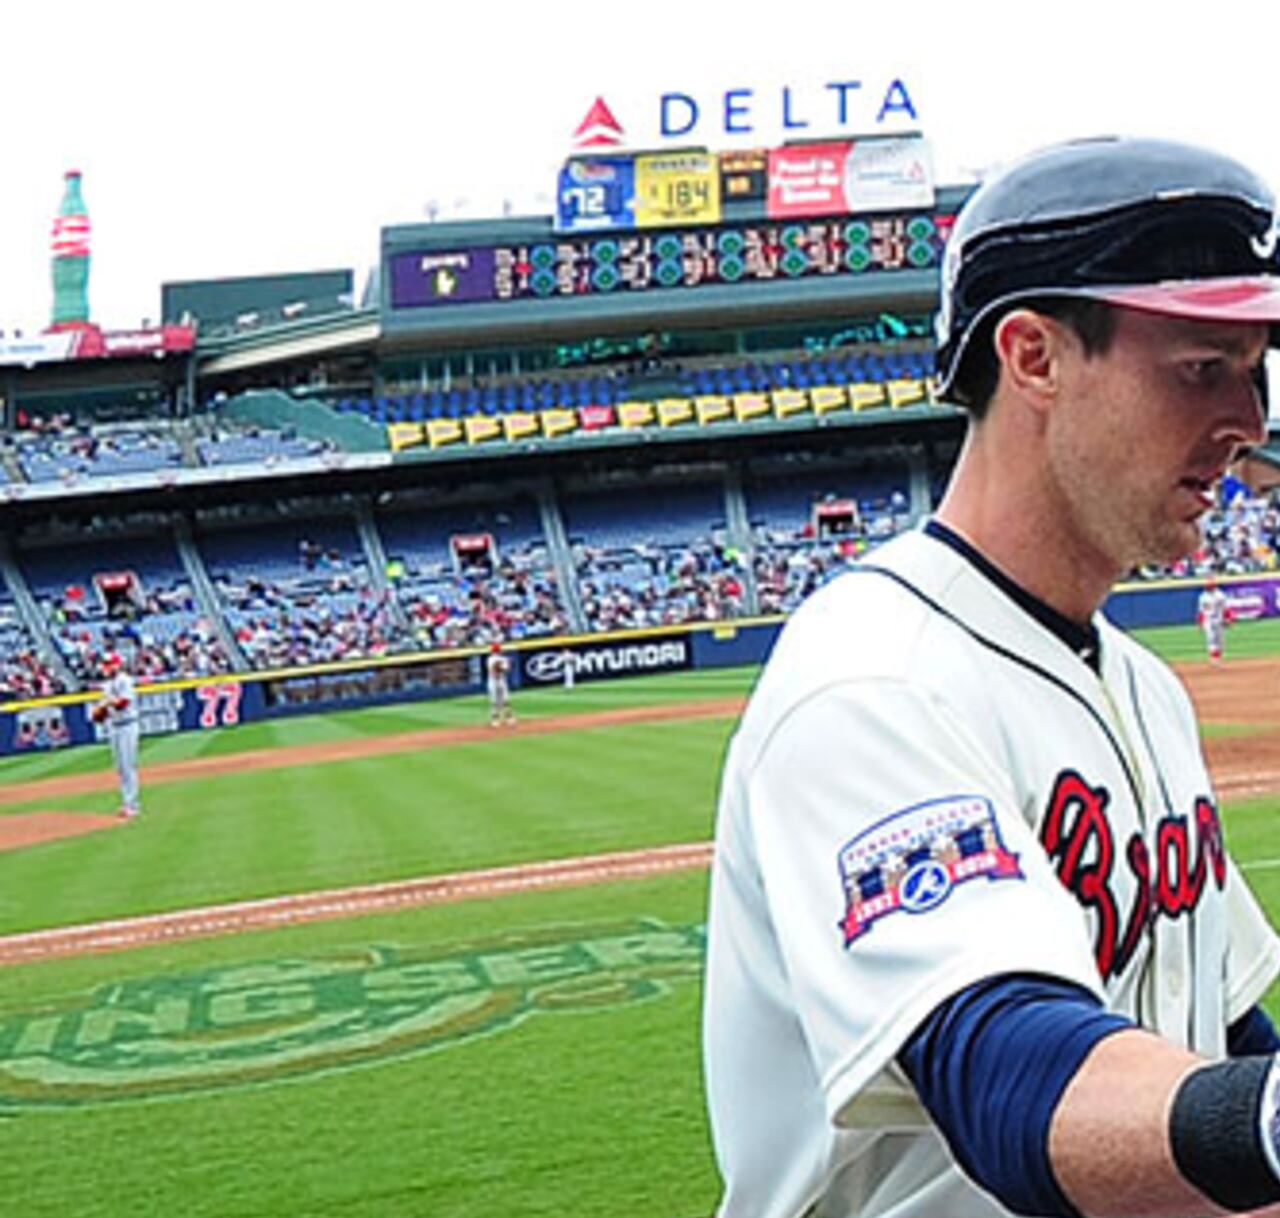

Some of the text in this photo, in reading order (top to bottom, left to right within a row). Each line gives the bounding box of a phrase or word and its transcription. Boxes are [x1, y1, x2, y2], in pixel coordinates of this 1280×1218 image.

[660, 78, 918, 138] DELTA
[574, 640, 686, 674] HYUNDAI
[197, 682, 242, 728] 77
